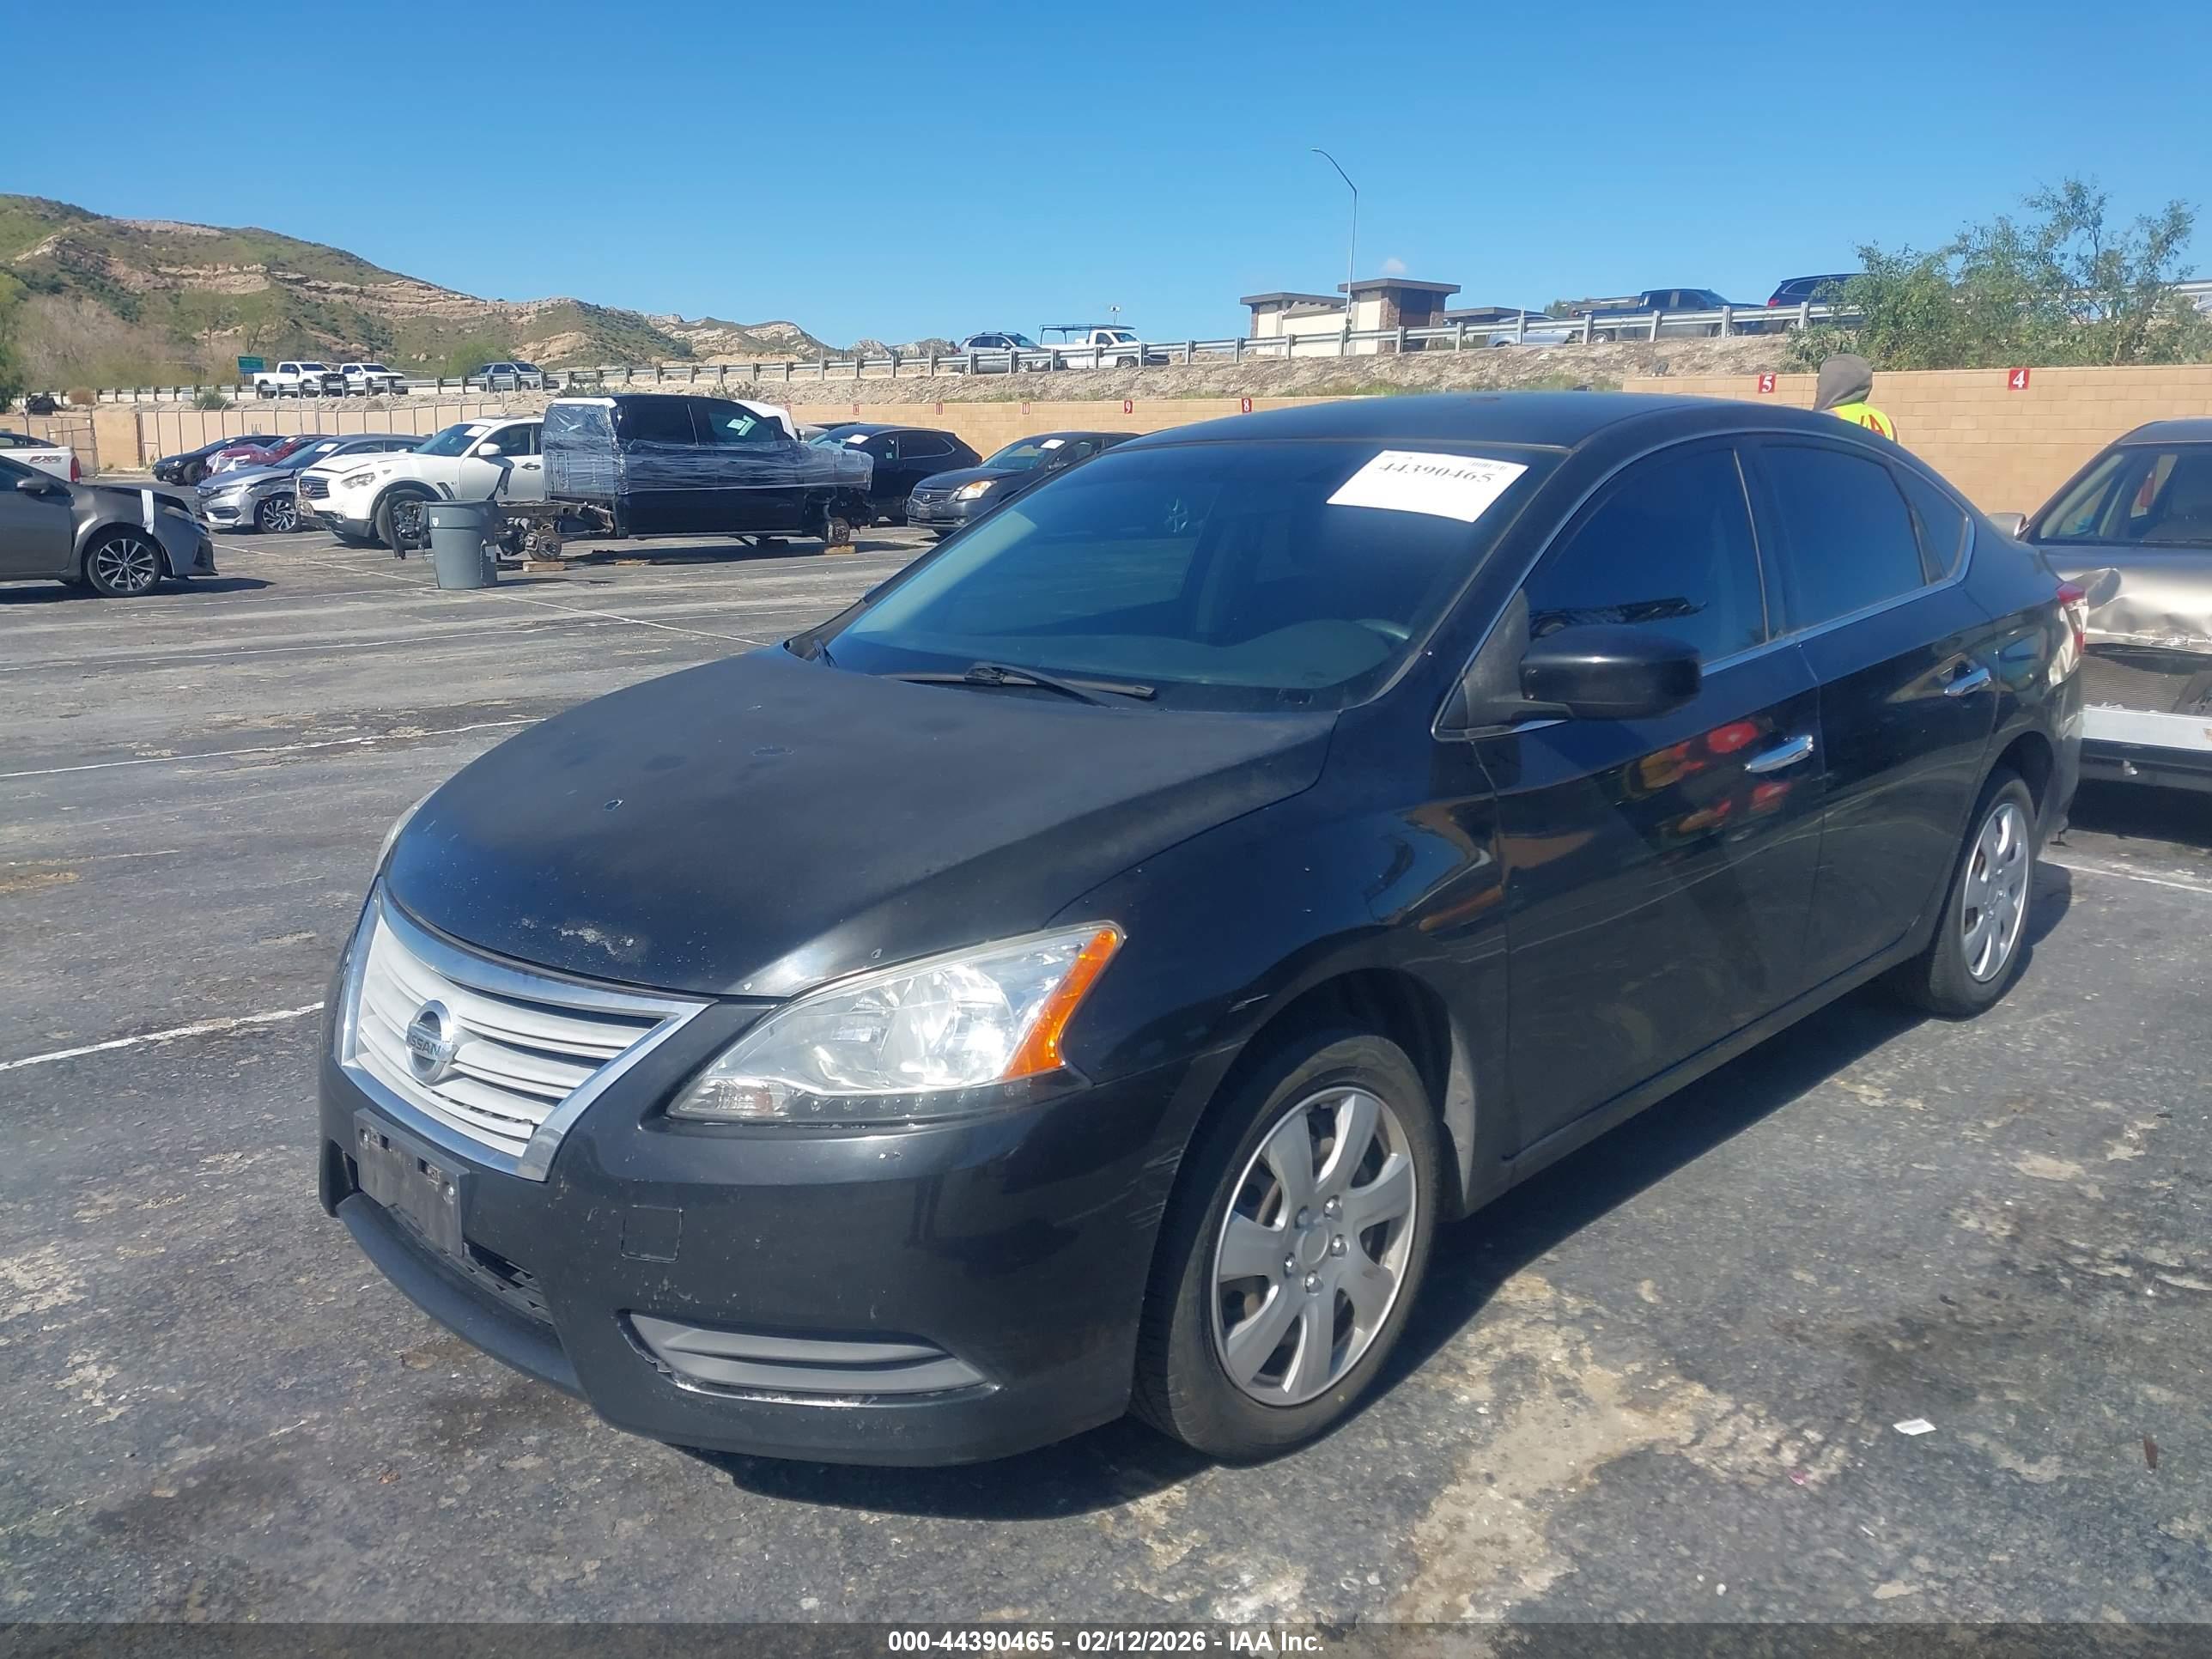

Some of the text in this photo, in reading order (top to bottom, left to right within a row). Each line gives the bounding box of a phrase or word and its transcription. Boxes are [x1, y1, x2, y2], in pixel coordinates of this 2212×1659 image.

[1761, 375, 1772, 392] 5
[2012, 370, 2025, 388] 4
[1379, 462, 1496, 483] 44390465
